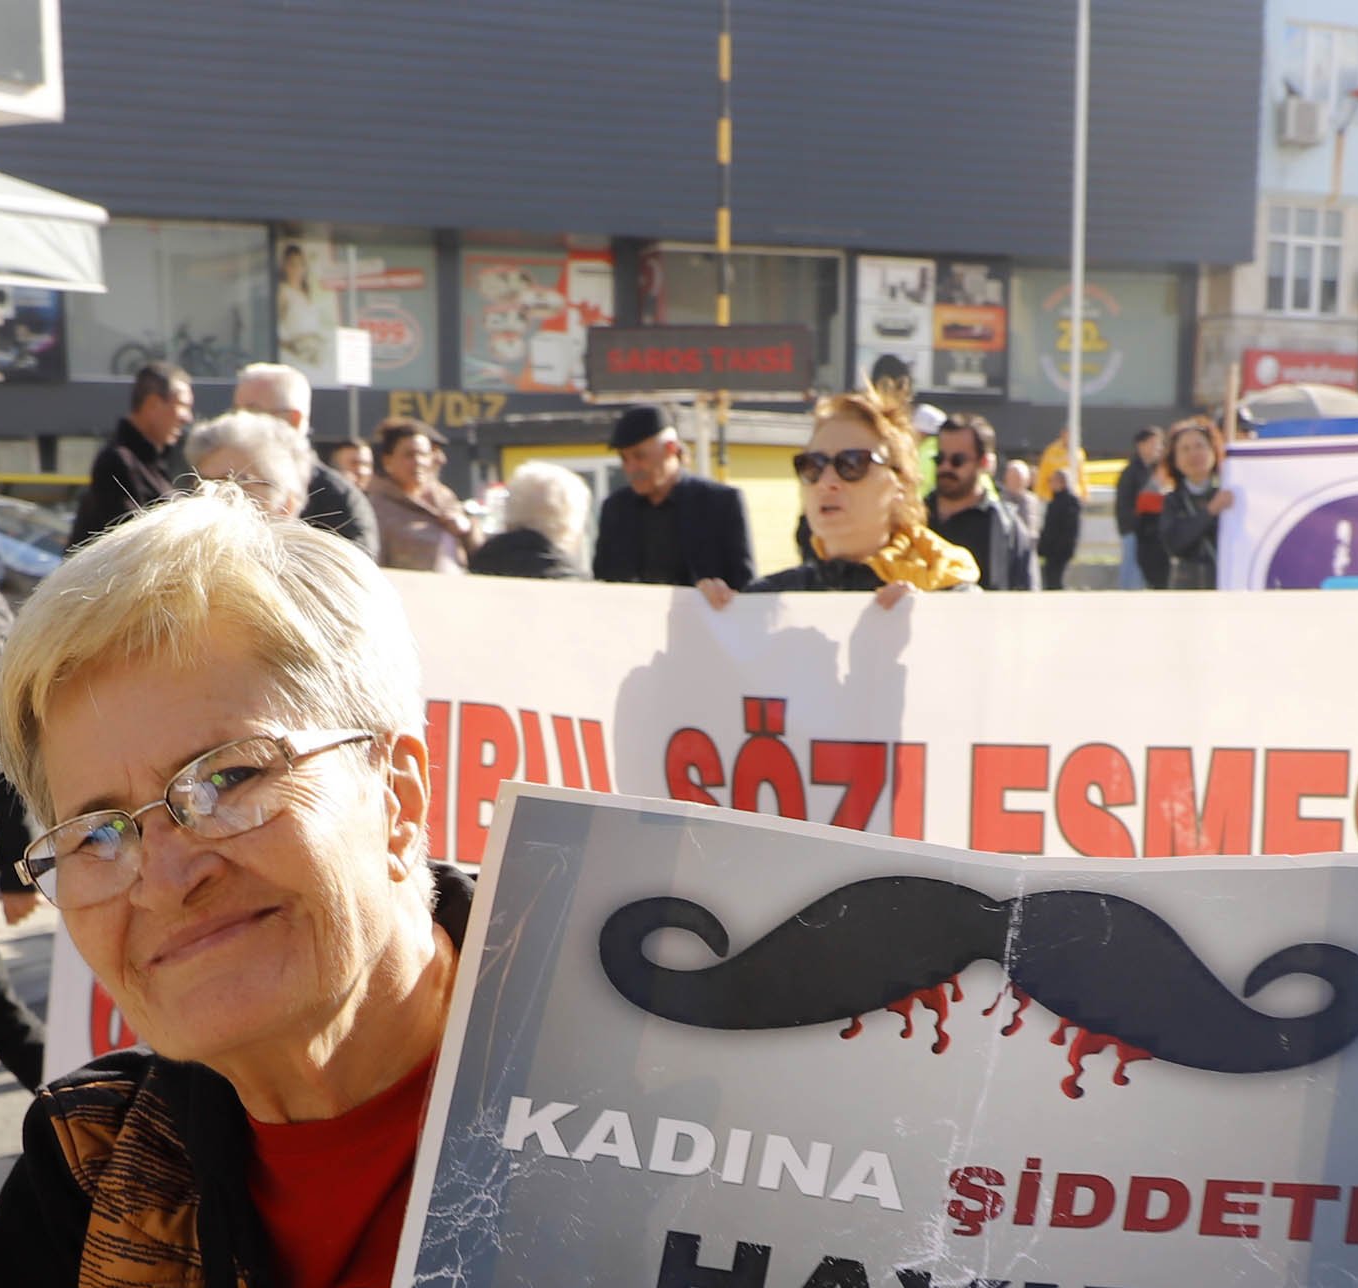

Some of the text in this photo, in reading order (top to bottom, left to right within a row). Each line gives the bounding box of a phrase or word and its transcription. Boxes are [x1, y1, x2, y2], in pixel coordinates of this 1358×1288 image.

[607, 340, 794, 373] SAROS TAKSİ
[501, 1096, 905, 1212] KADINA
